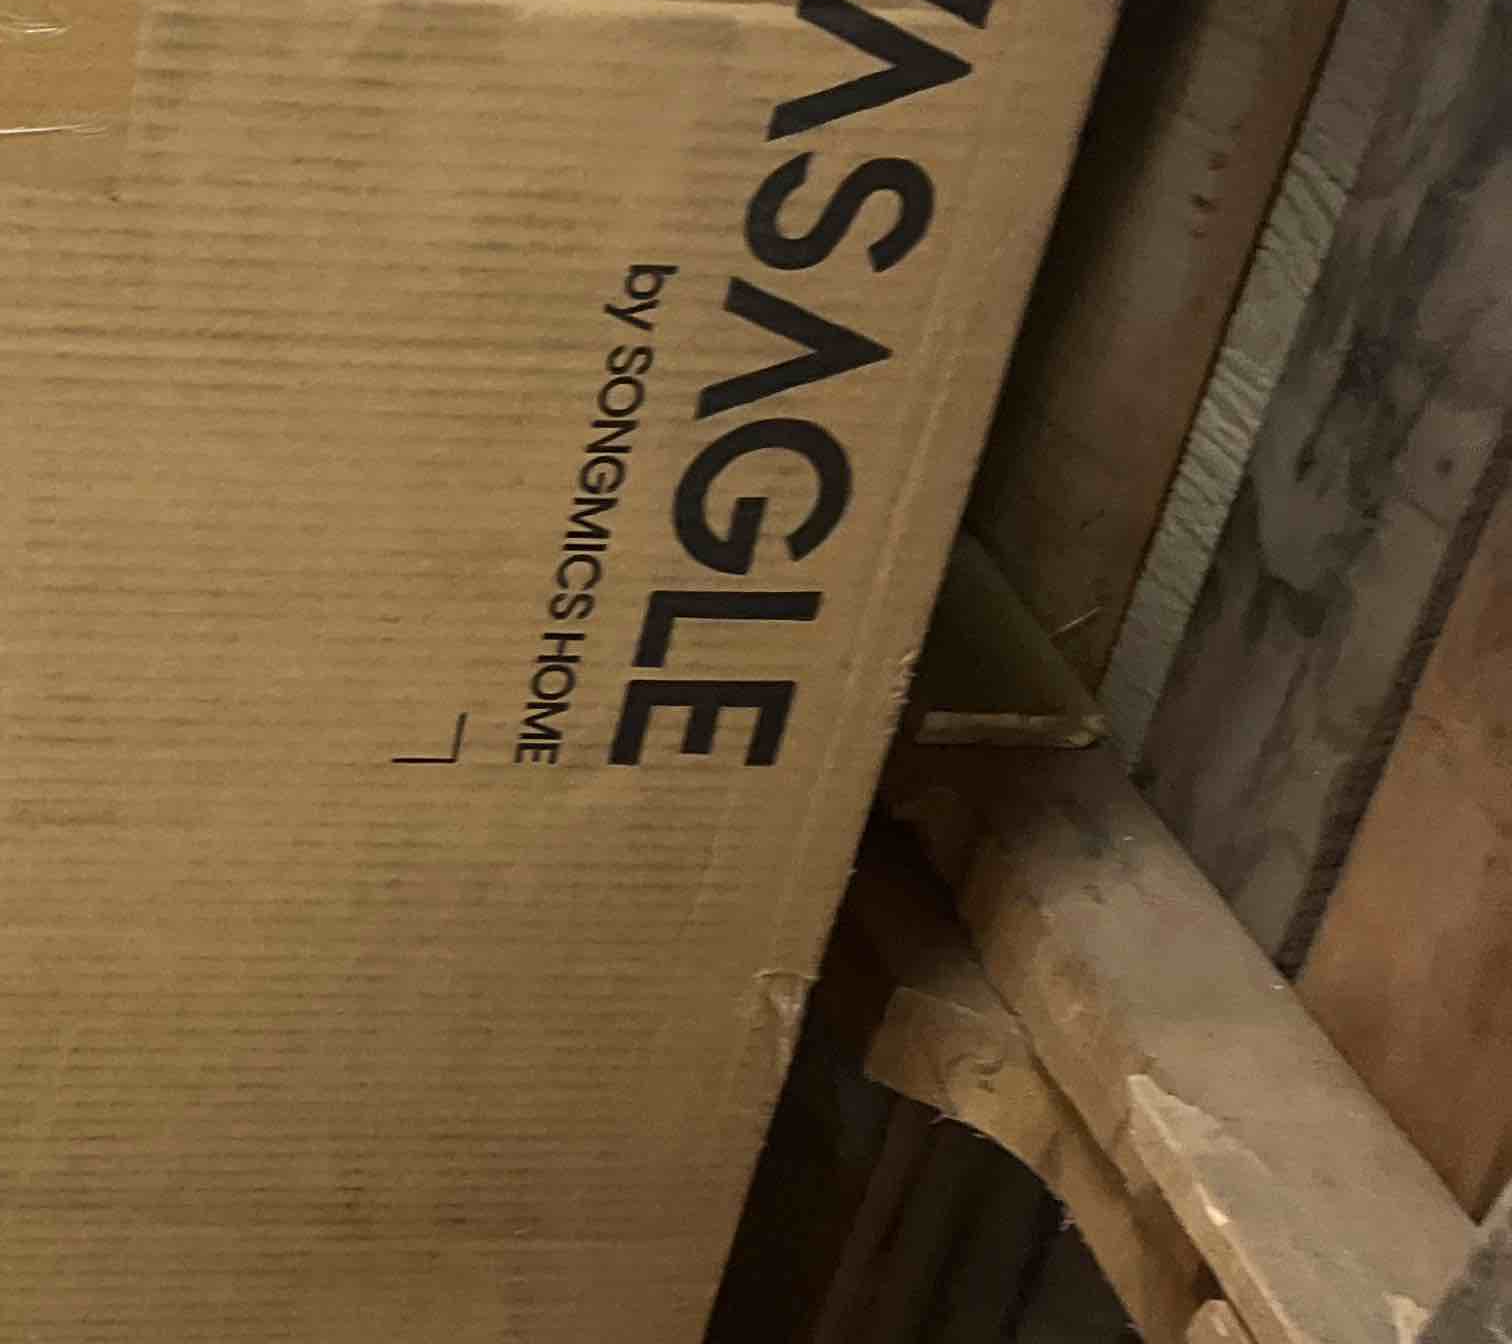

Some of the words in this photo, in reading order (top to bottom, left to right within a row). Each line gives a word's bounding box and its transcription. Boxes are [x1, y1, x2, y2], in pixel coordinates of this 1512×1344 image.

[603, 264, 678, 330] by
[547, 345, 655, 621] SONGMICS
[514, 632, 586, 765] HOME
